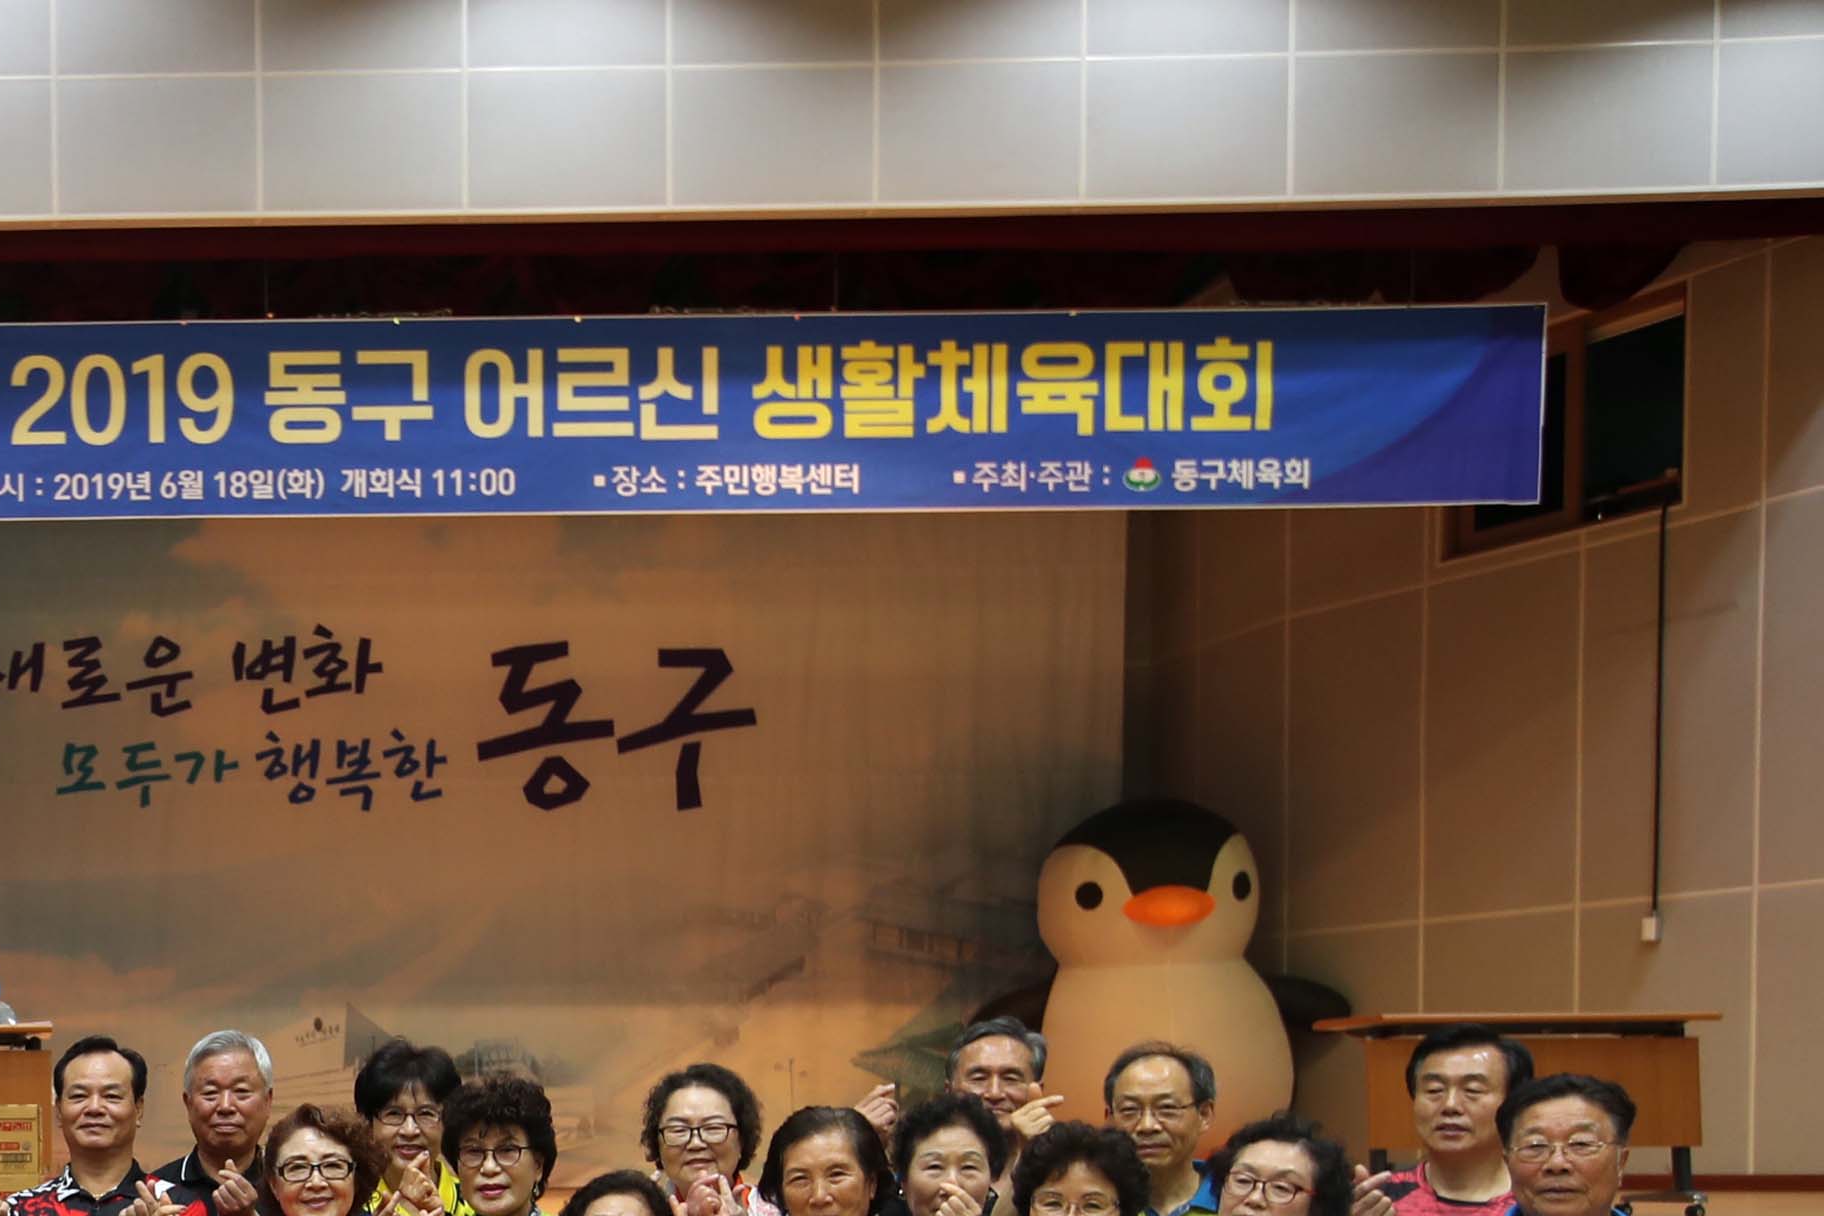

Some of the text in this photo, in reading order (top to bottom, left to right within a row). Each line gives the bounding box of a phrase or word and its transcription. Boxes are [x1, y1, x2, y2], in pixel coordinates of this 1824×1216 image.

[10, 337, 1274, 446] 2019 동구 어르신 생활체육대회
[53, 470, 152, 501] 2019년
[159, 469, 204, 501] 6월
[213, 468, 325, 501] 18일(화)
[340, 467, 422, 499] 개회식
[431, 467, 517, 498] 11:00
[610, 464, 669, 498] 장소
[694, 462, 862, 497] 주민행복센터
[1171, 457, 1311, 492] 동구체육회
[231, 623, 384, 716] 변화
[477, 640, 758, 812] 동구
[55, 728, 448, 812] 모두가 행복한
